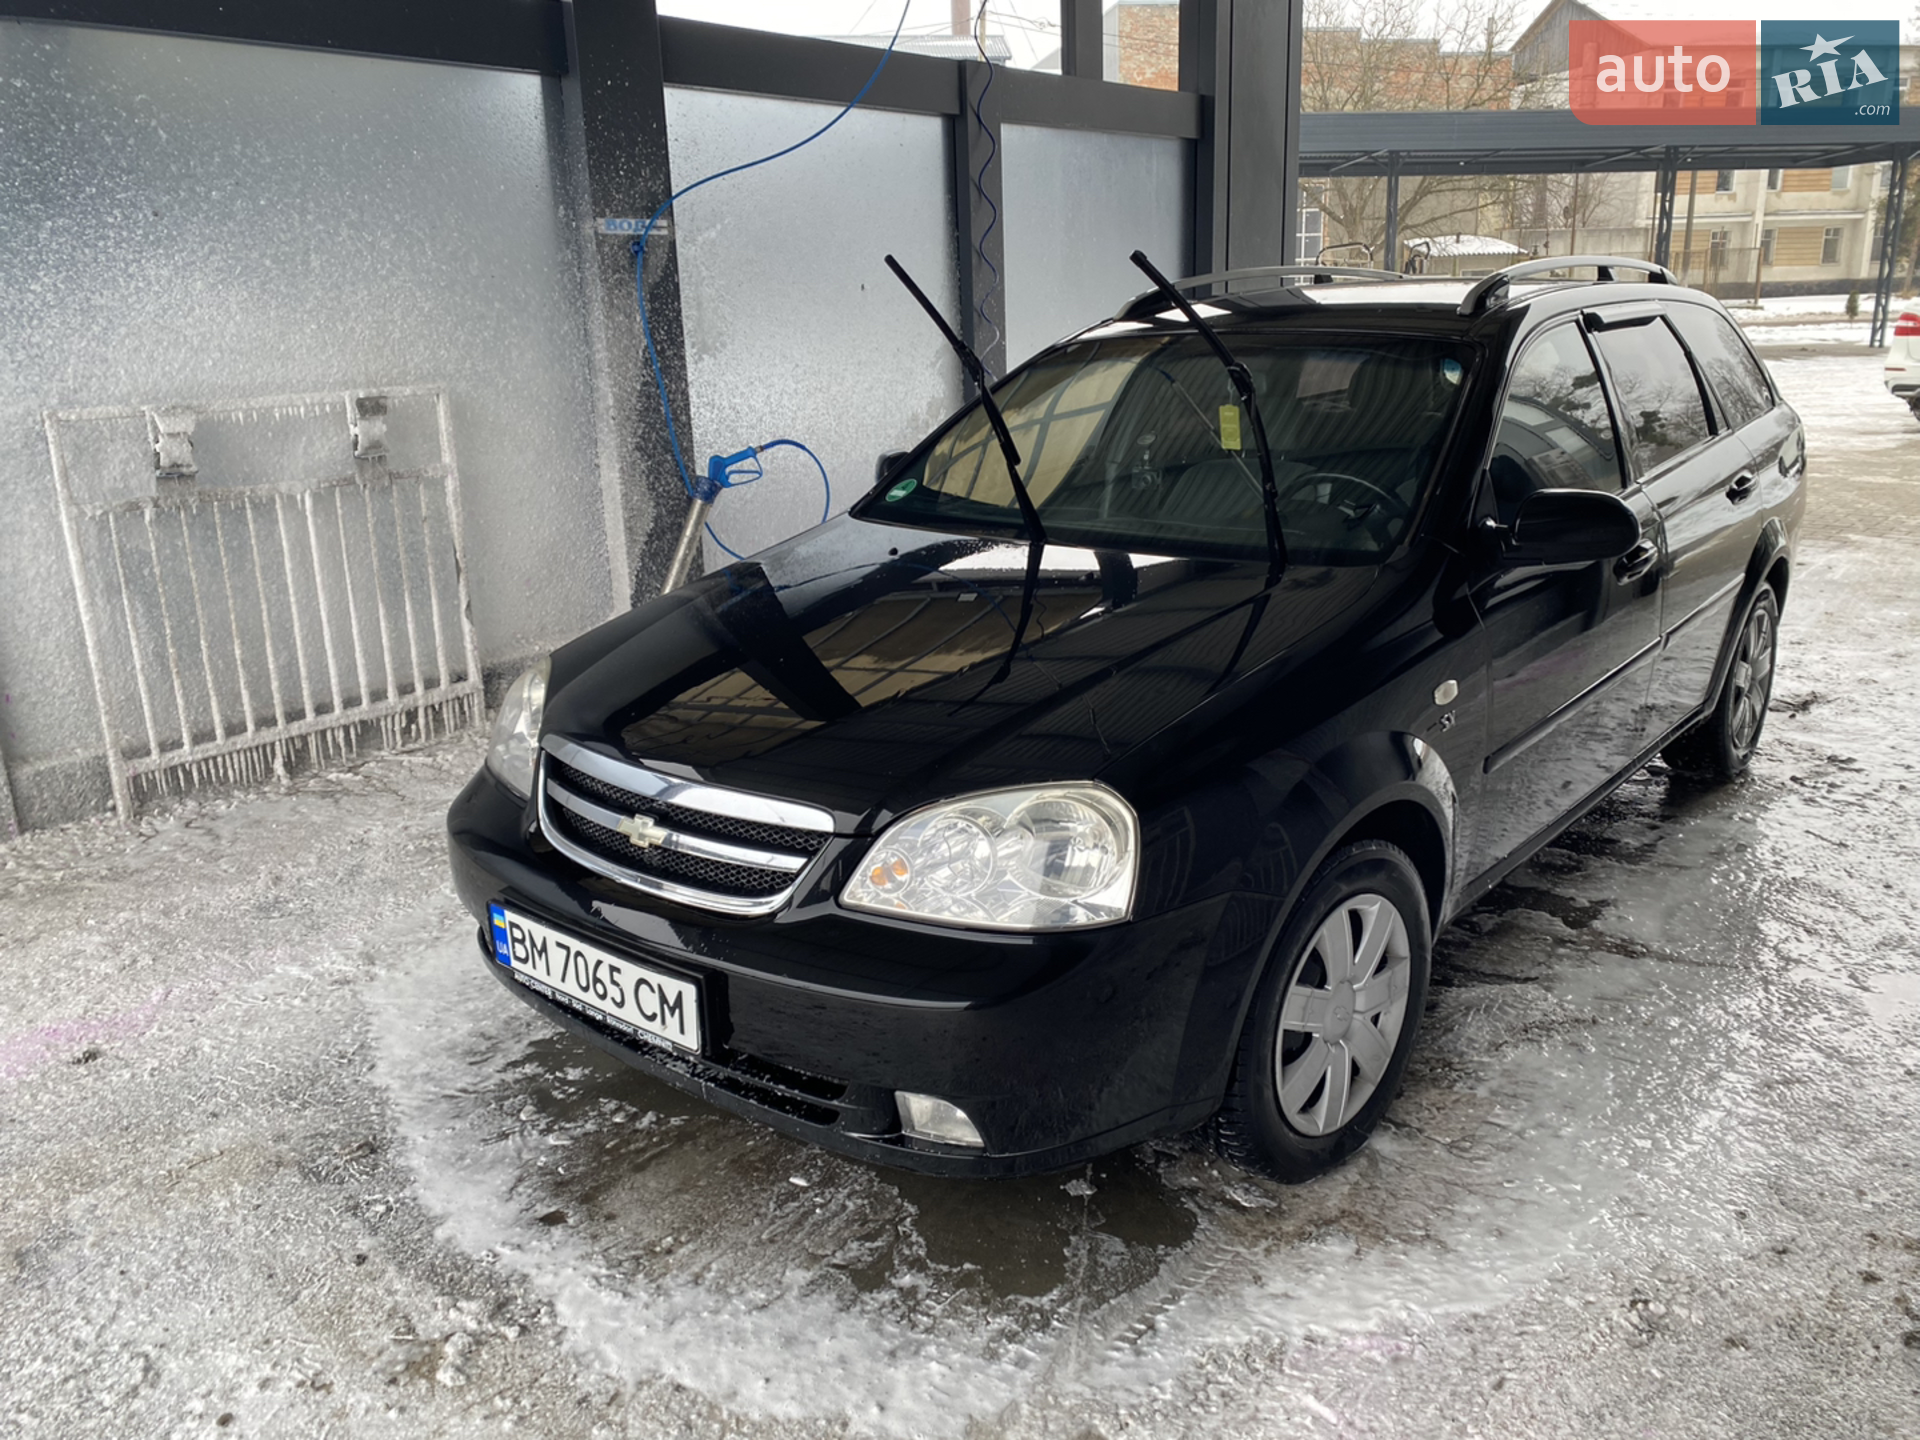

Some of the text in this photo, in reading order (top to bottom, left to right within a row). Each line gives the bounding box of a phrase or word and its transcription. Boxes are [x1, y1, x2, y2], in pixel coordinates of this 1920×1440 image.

[604, 218, 662, 232] ВОД
[496, 941, 508, 956] UA
[508, 920, 685, 1035] BM 7065 CM
